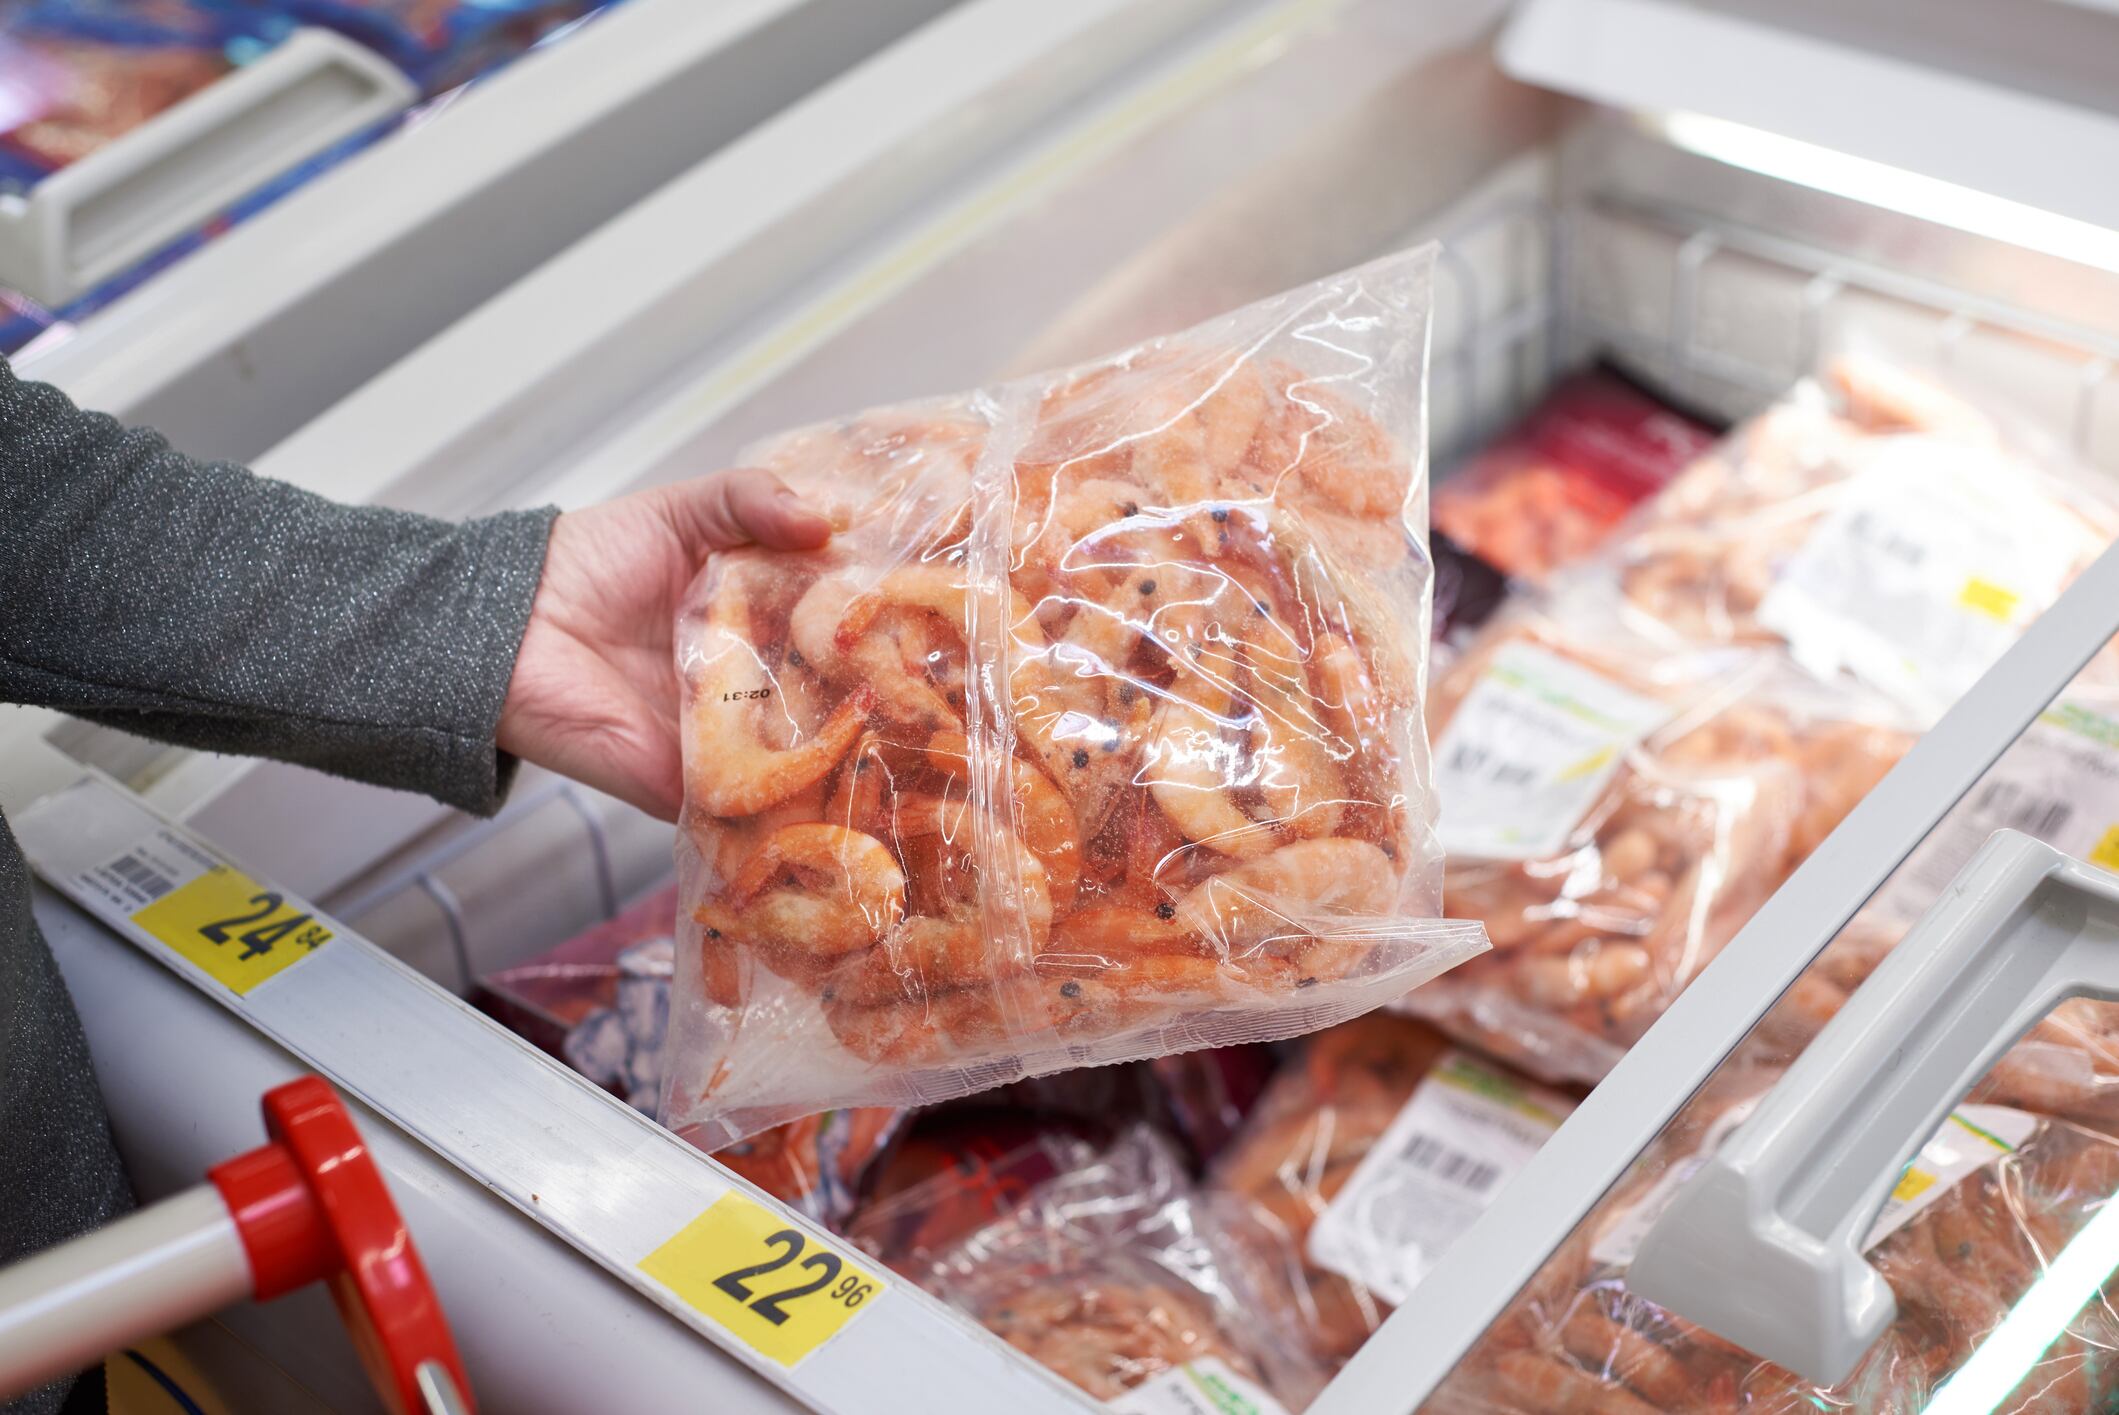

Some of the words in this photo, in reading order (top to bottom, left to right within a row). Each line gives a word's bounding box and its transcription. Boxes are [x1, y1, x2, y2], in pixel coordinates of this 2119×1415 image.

[723, 688, 771, 703] 02:31
[198, 892, 313, 960] 24
[712, 1229, 843, 1327] 22
[831, 1276, 873, 1308] 96
